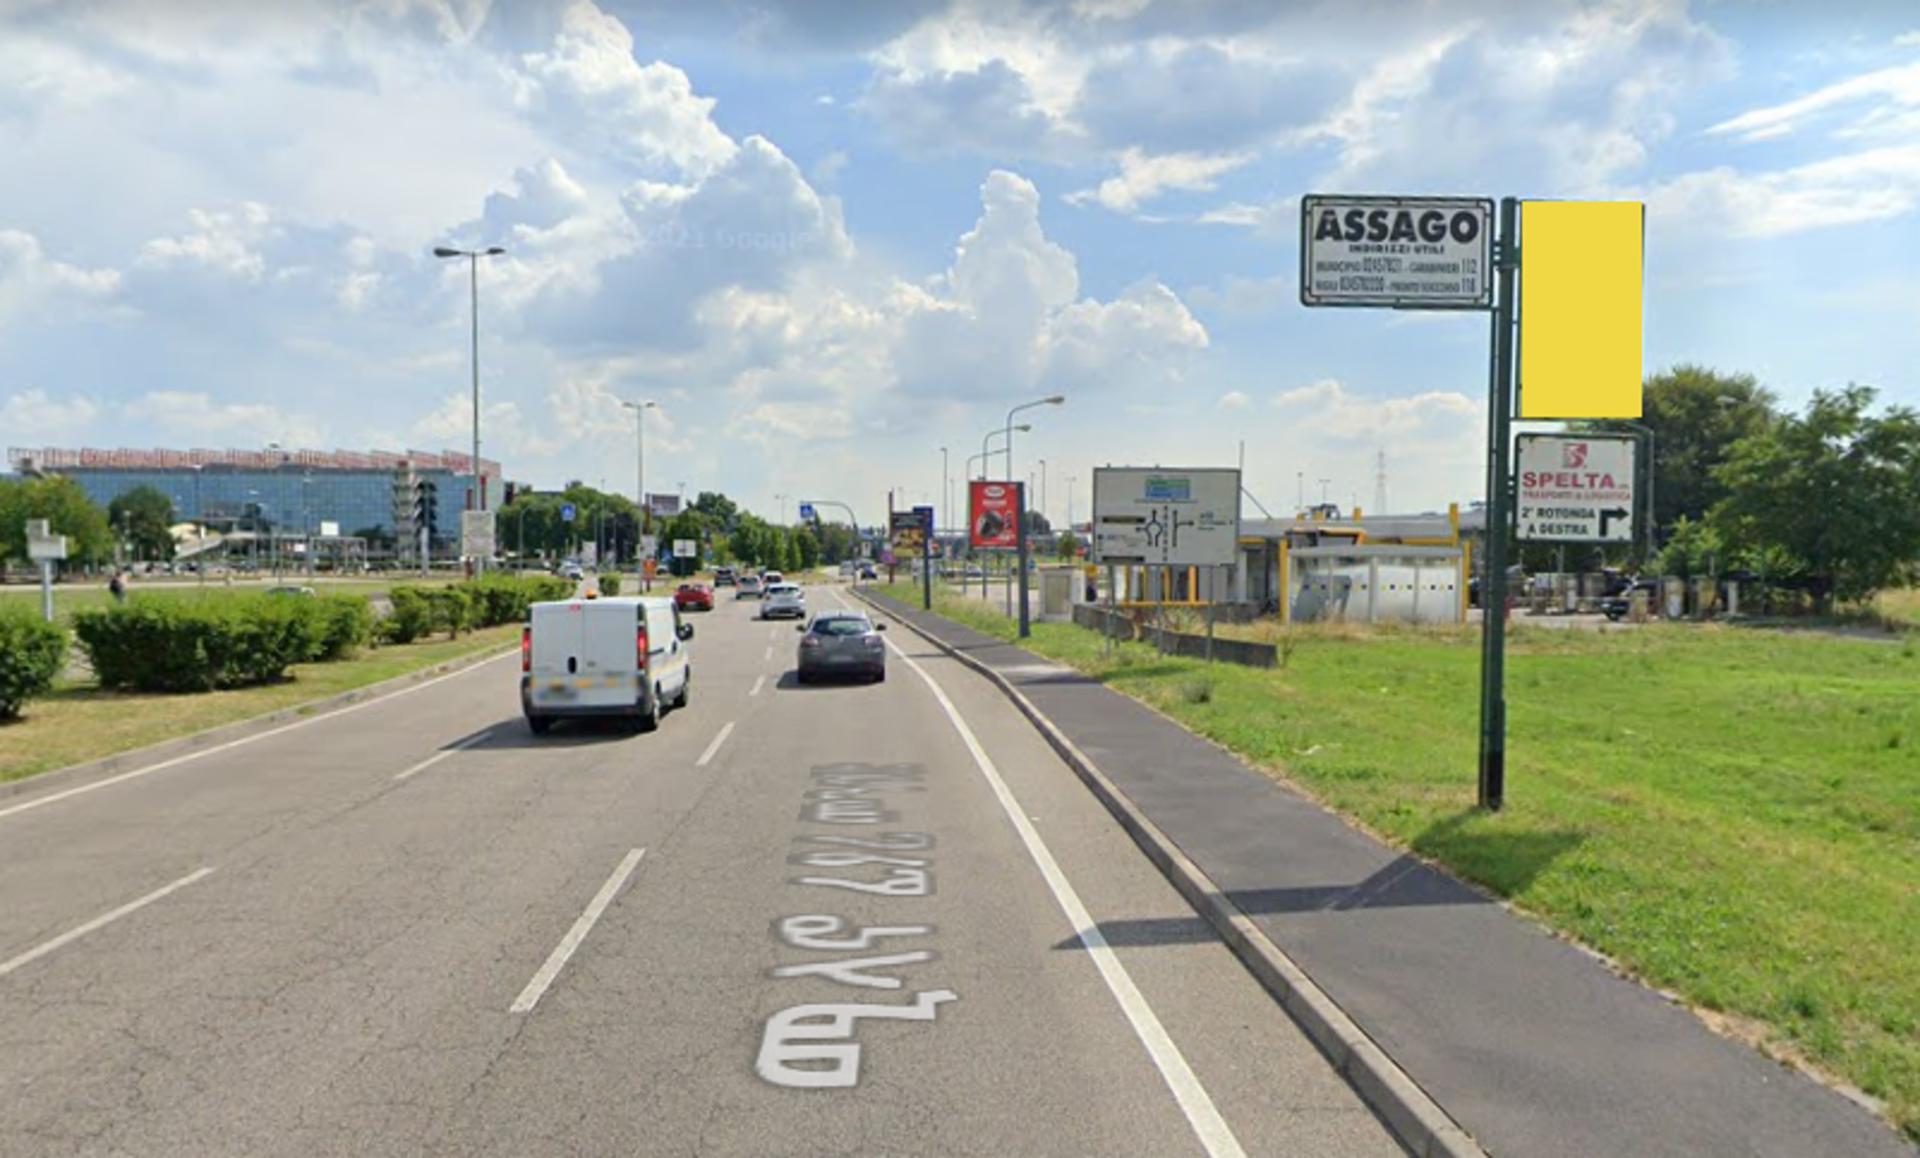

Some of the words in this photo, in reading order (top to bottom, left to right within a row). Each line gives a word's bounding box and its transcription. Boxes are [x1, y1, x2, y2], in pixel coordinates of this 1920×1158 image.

[1315, 209, 1479, 243] ASSAGO
[1349, 244, 1410, 254] INDIRIZZI
[1414, 244, 1445, 254] UTILI
[1462, 258, 1477, 274] 112
[1522, 472, 1615, 489] SPELTA
[1537, 507, 1596, 519] ROTONDA
[1528, 523, 1536, 535] A
[1539, 523, 1589, 535] DESTRA
